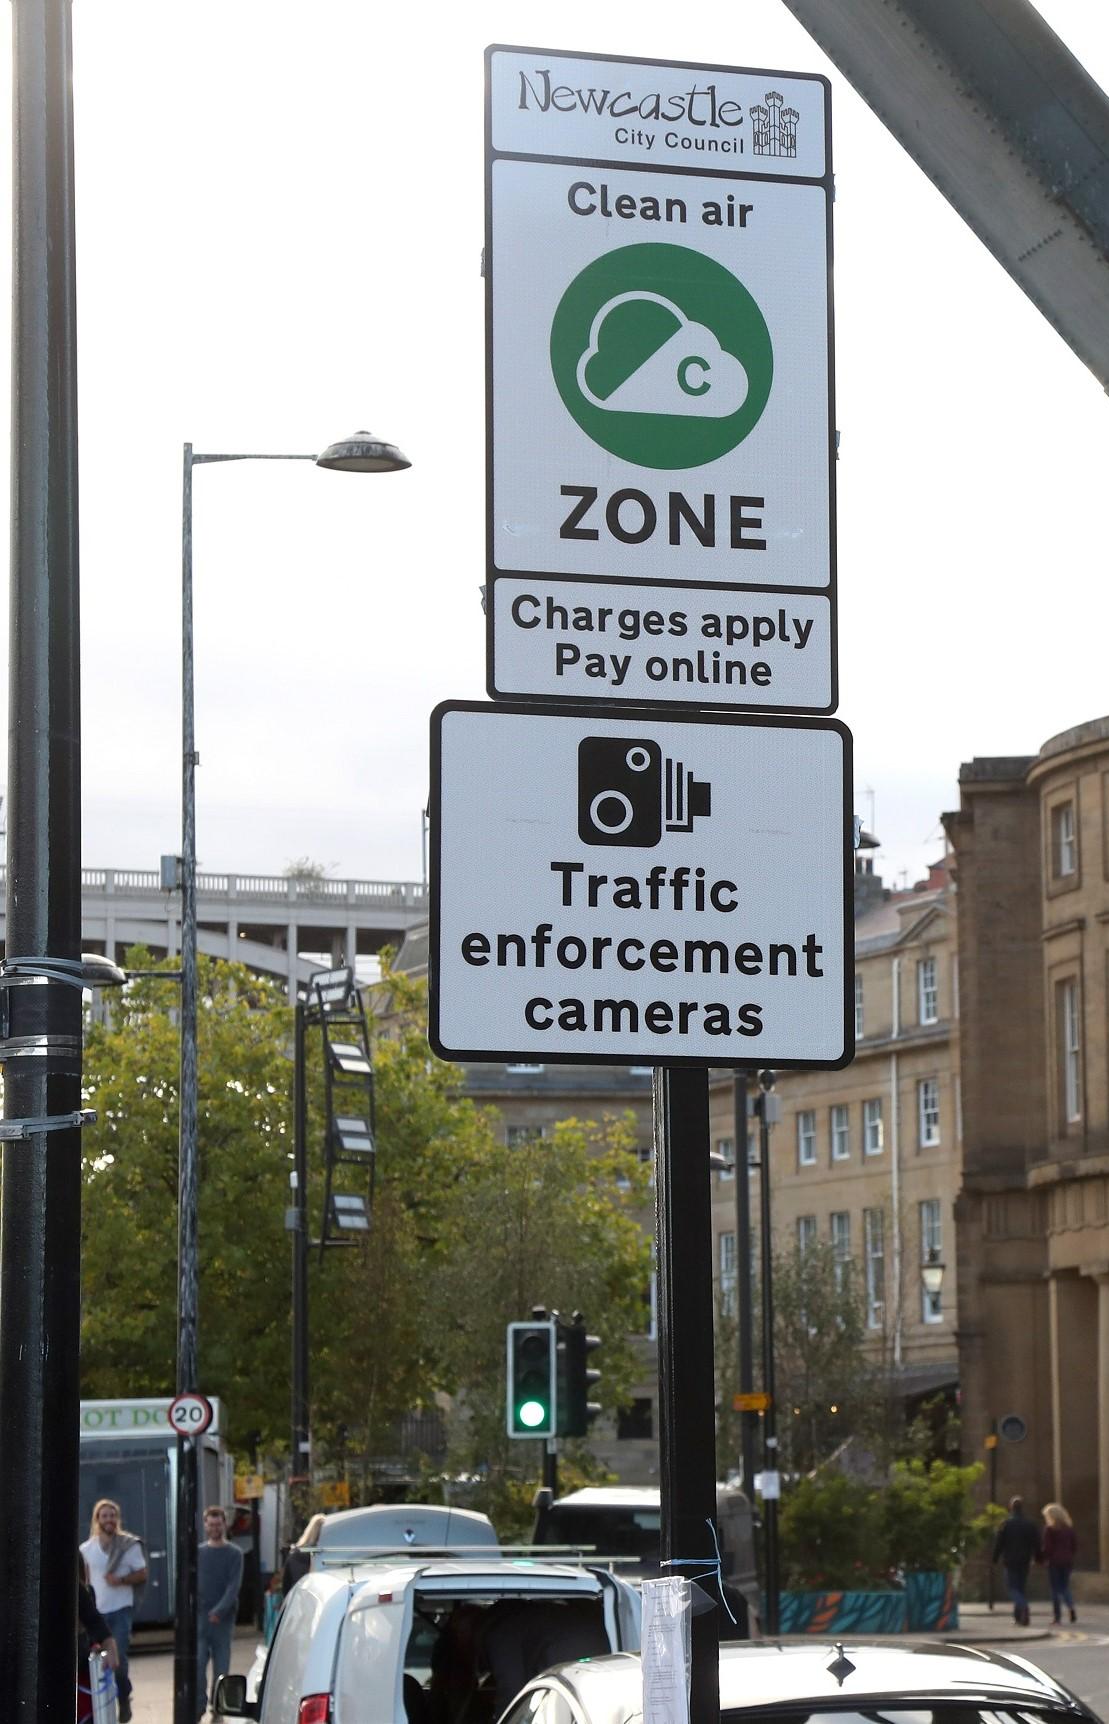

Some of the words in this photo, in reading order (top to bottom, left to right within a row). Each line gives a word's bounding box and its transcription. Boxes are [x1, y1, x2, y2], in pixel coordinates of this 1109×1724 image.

[518, 69, 743, 128] Newcastle
[614, 127, 656, 150] City
[664, 131, 744, 154] Council
[567, 181, 687, 224] Clean
[701, 194, 754, 228] air
[676, 355, 712, 397] C
[559, 484, 767, 551] ZONE
[511, 594, 688, 641] Charges
[700, 608, 814, 650] apply
[555, 642, 632, 686] Pay
[645, 649, 772, 687] online
[550, 861, 739, 913] Traffic
[461, 923, 824, 978] enforcement
[524, 997, 764, 1037] cameras
[84, 1408, 122, 1428] OT
[132, 1408, 168, 1426] DO
[174, 1406, 203, 1424] 20
